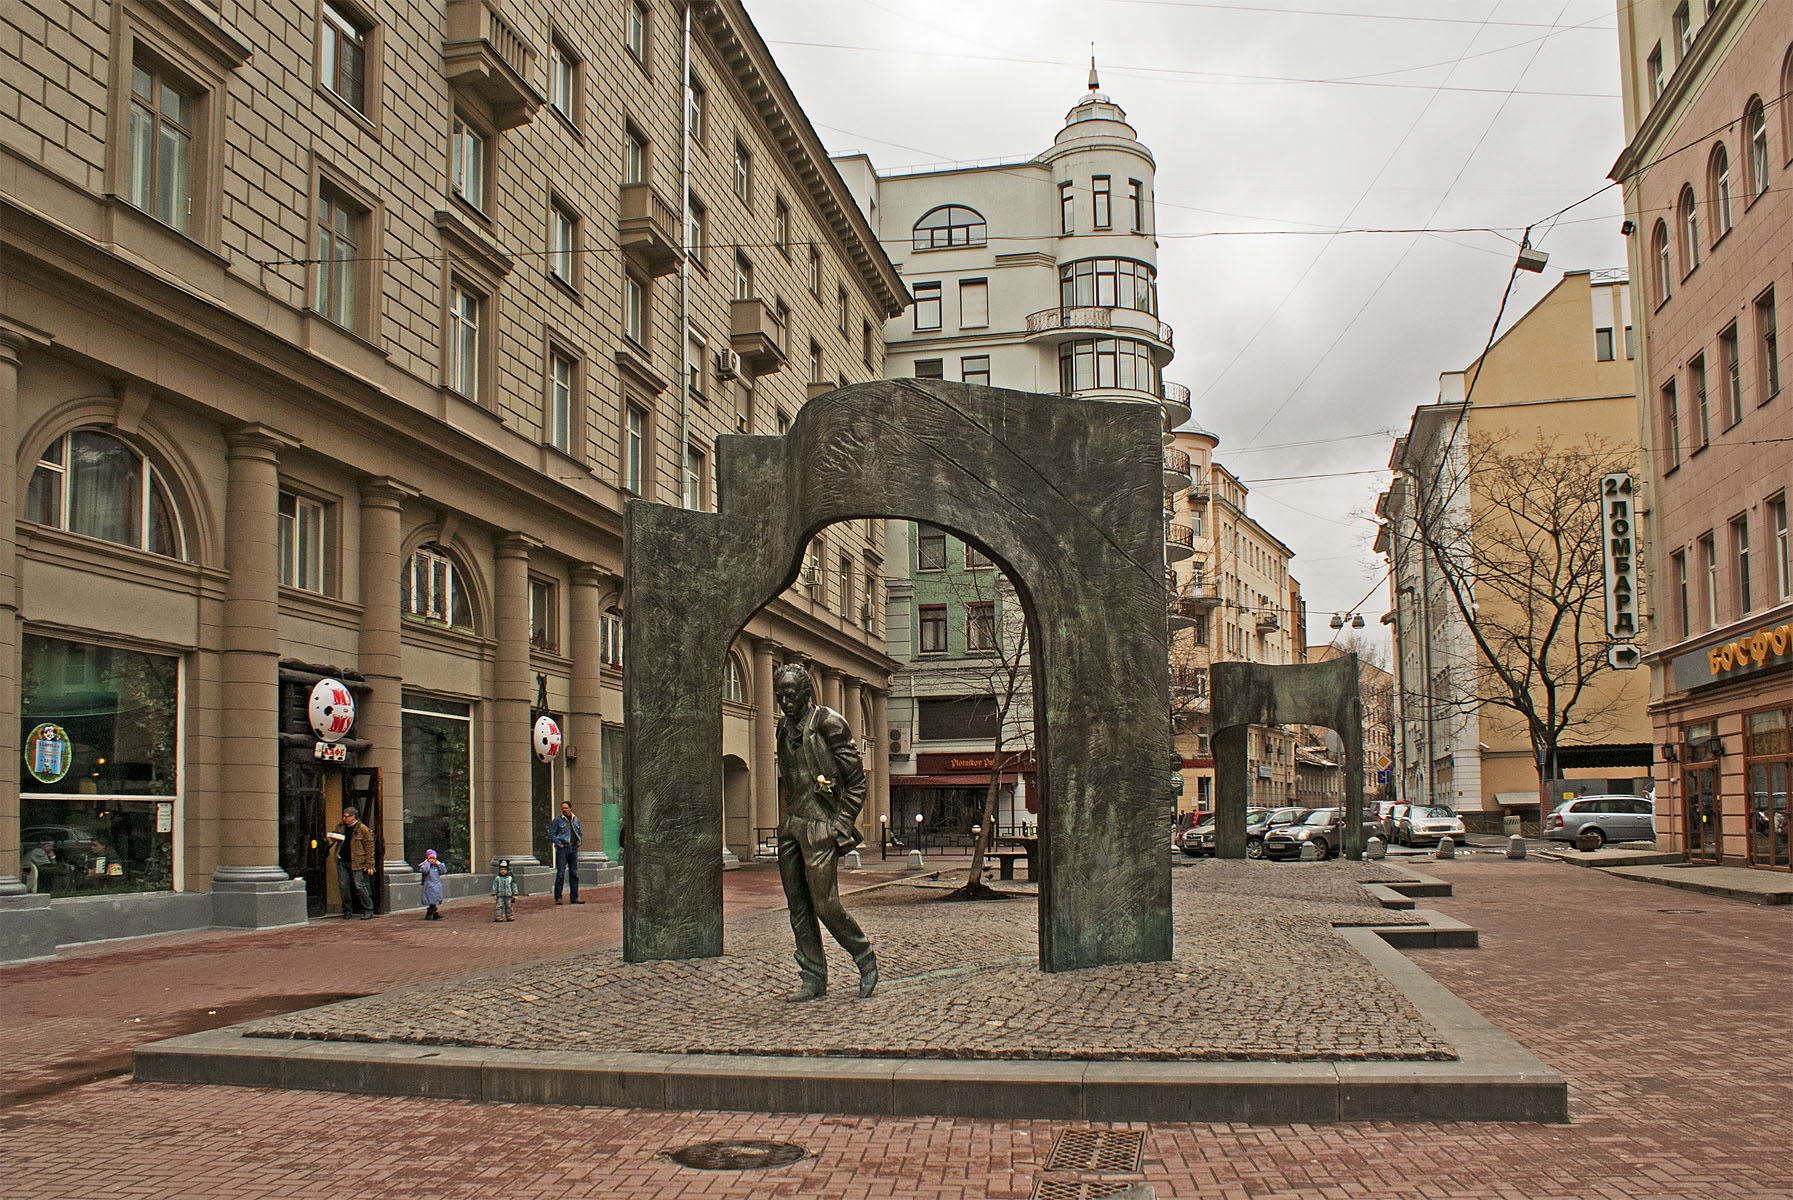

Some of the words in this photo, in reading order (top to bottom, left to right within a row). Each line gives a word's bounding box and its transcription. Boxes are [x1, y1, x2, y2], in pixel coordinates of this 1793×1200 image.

[1604, 478, 1633, 496] 24
[1608, 501, 1635, 635] ЛОМБАРД
[1707, 622, 1793, 676] БОСФО
[321, 745, 345, 758] КАФЕ
[983, 757, 995, 768] Pu
